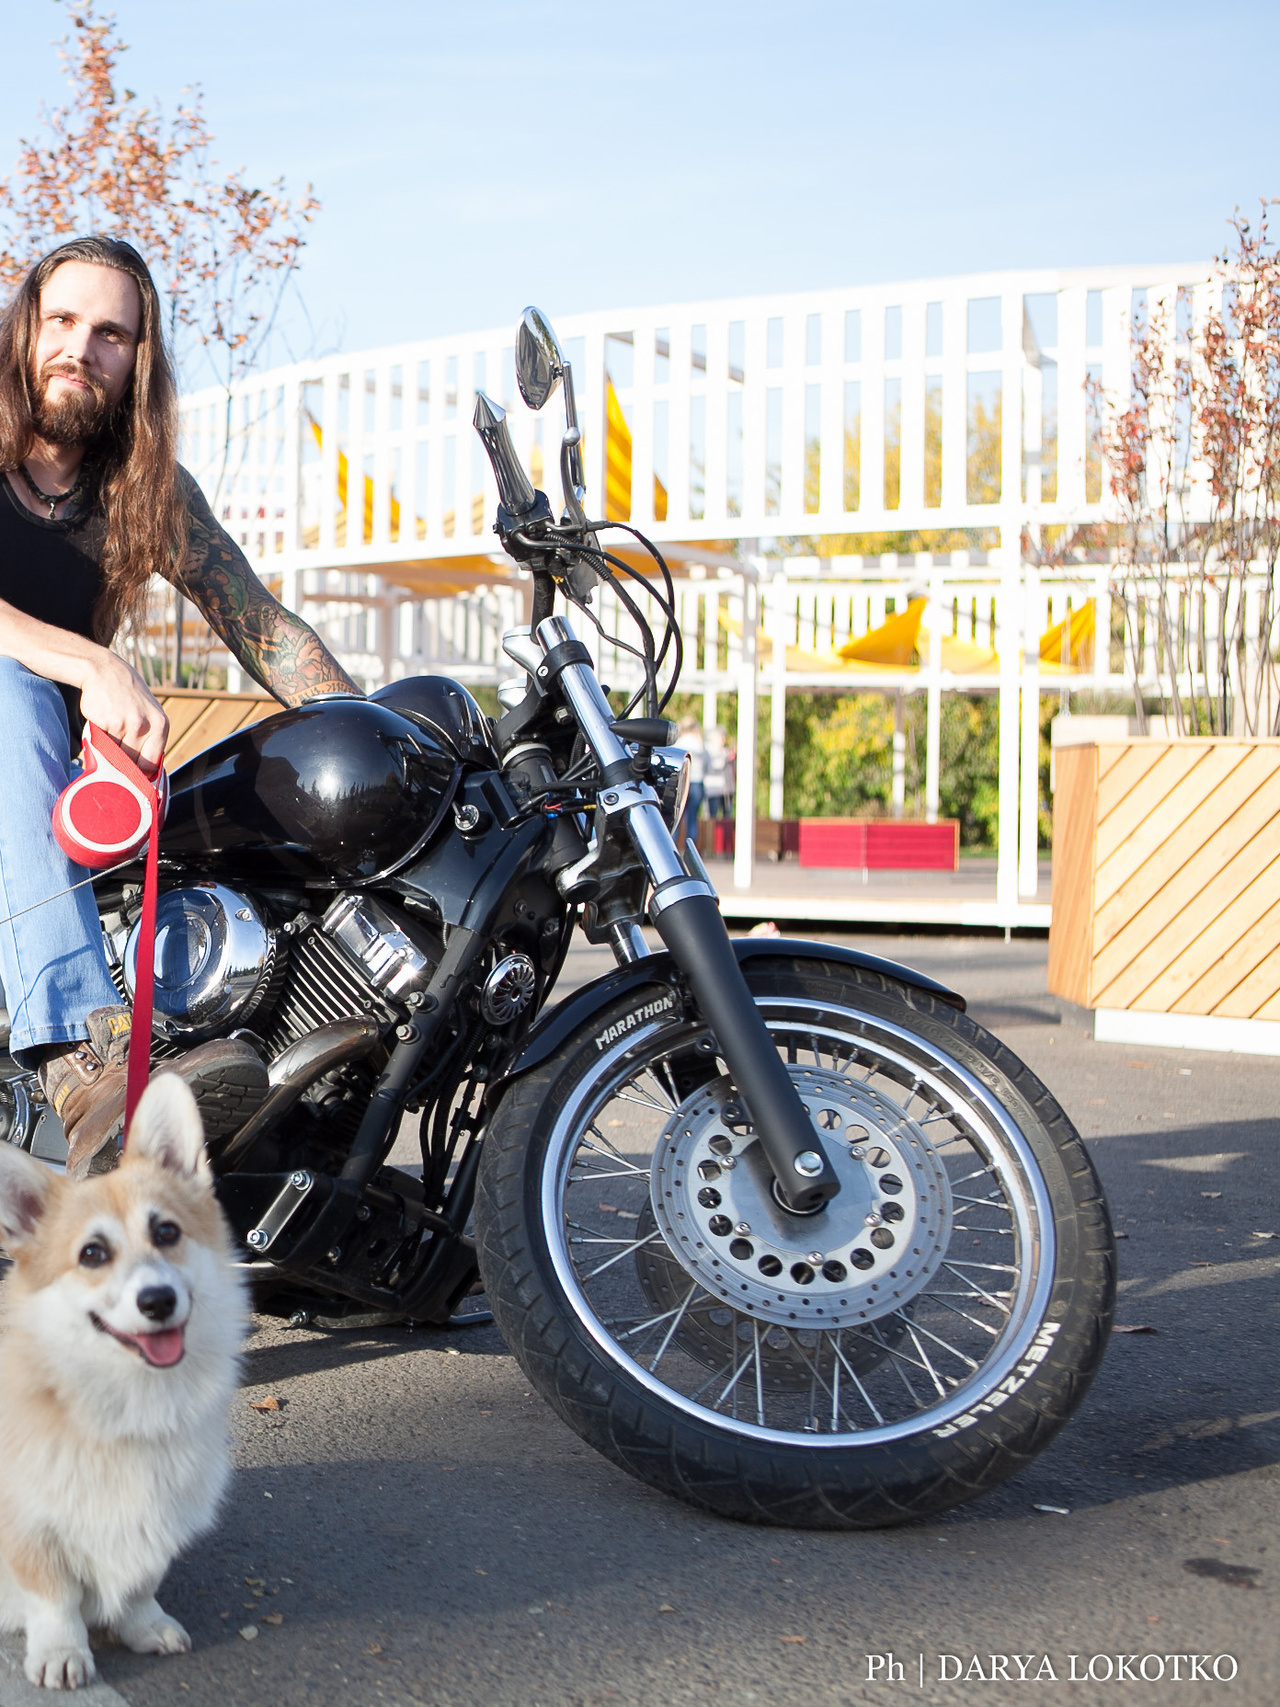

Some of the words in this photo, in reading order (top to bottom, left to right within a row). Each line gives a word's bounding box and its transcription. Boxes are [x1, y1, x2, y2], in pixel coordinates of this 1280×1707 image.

[107, 1013, 132, 1035] CAT
[595, 997, 673, 1050] MARATHON
[932, 1321, 1061, 1438] METZELER
